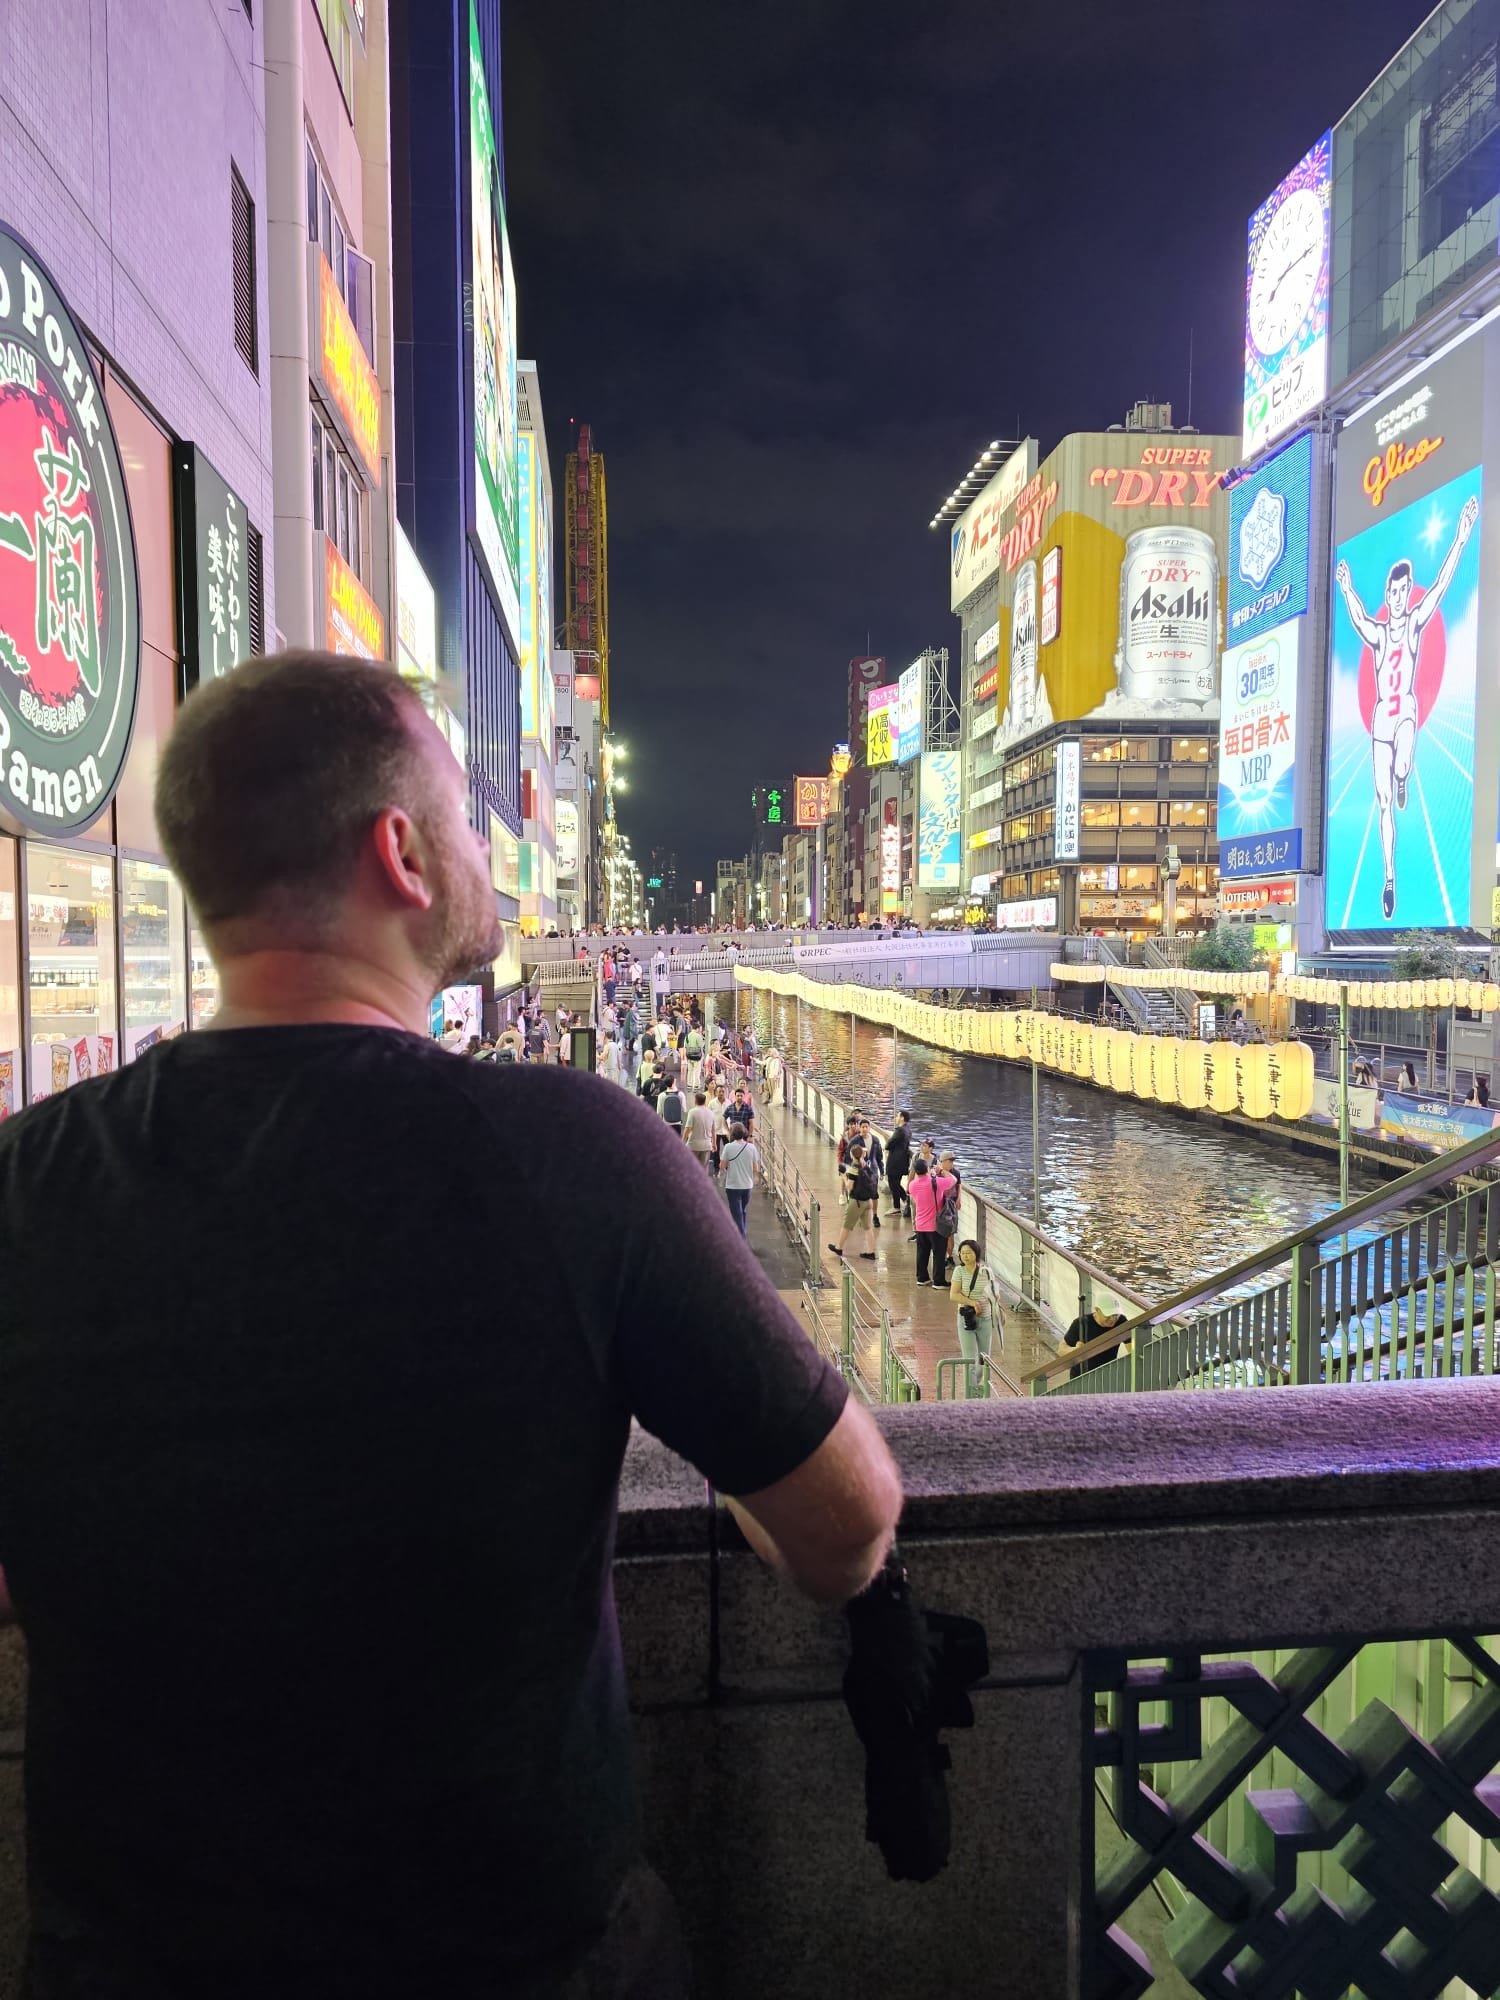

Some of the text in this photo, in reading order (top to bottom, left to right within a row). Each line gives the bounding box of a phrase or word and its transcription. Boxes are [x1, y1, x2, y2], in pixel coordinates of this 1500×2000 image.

[21, 260, 100, 447] Pork
[1140, 447, 1212, 465] SUPER
[1364, 437, 1443, 506] Glico
[1015, 473, 1042, 517] SUPER
[225, 493, 240, 669] こだわり
[331, 560, 357, 625] LONG
[1130, 585, 1208, 622] Asahi
[1013, 614, 1035, 658] Asahi
[1146, 650, 1193, 659] スーパードライ
[1160, 624, 1180, 639] 生
[1389, 643, 1403, 717] グリコ
[870, 715, 879, 762] バイト
[1225, 711, 1291, 756] 毎日骨太
[1240, 754, 1272, 787] MBP
[1223, 892, 1260, 904] LOTTERIA
[1204, 1053, 1215, 1101] 三津寺
[1235, 1057, 1244, 1109] 三津寺
[1268, 1053, 1283, 1109] 三津寺
